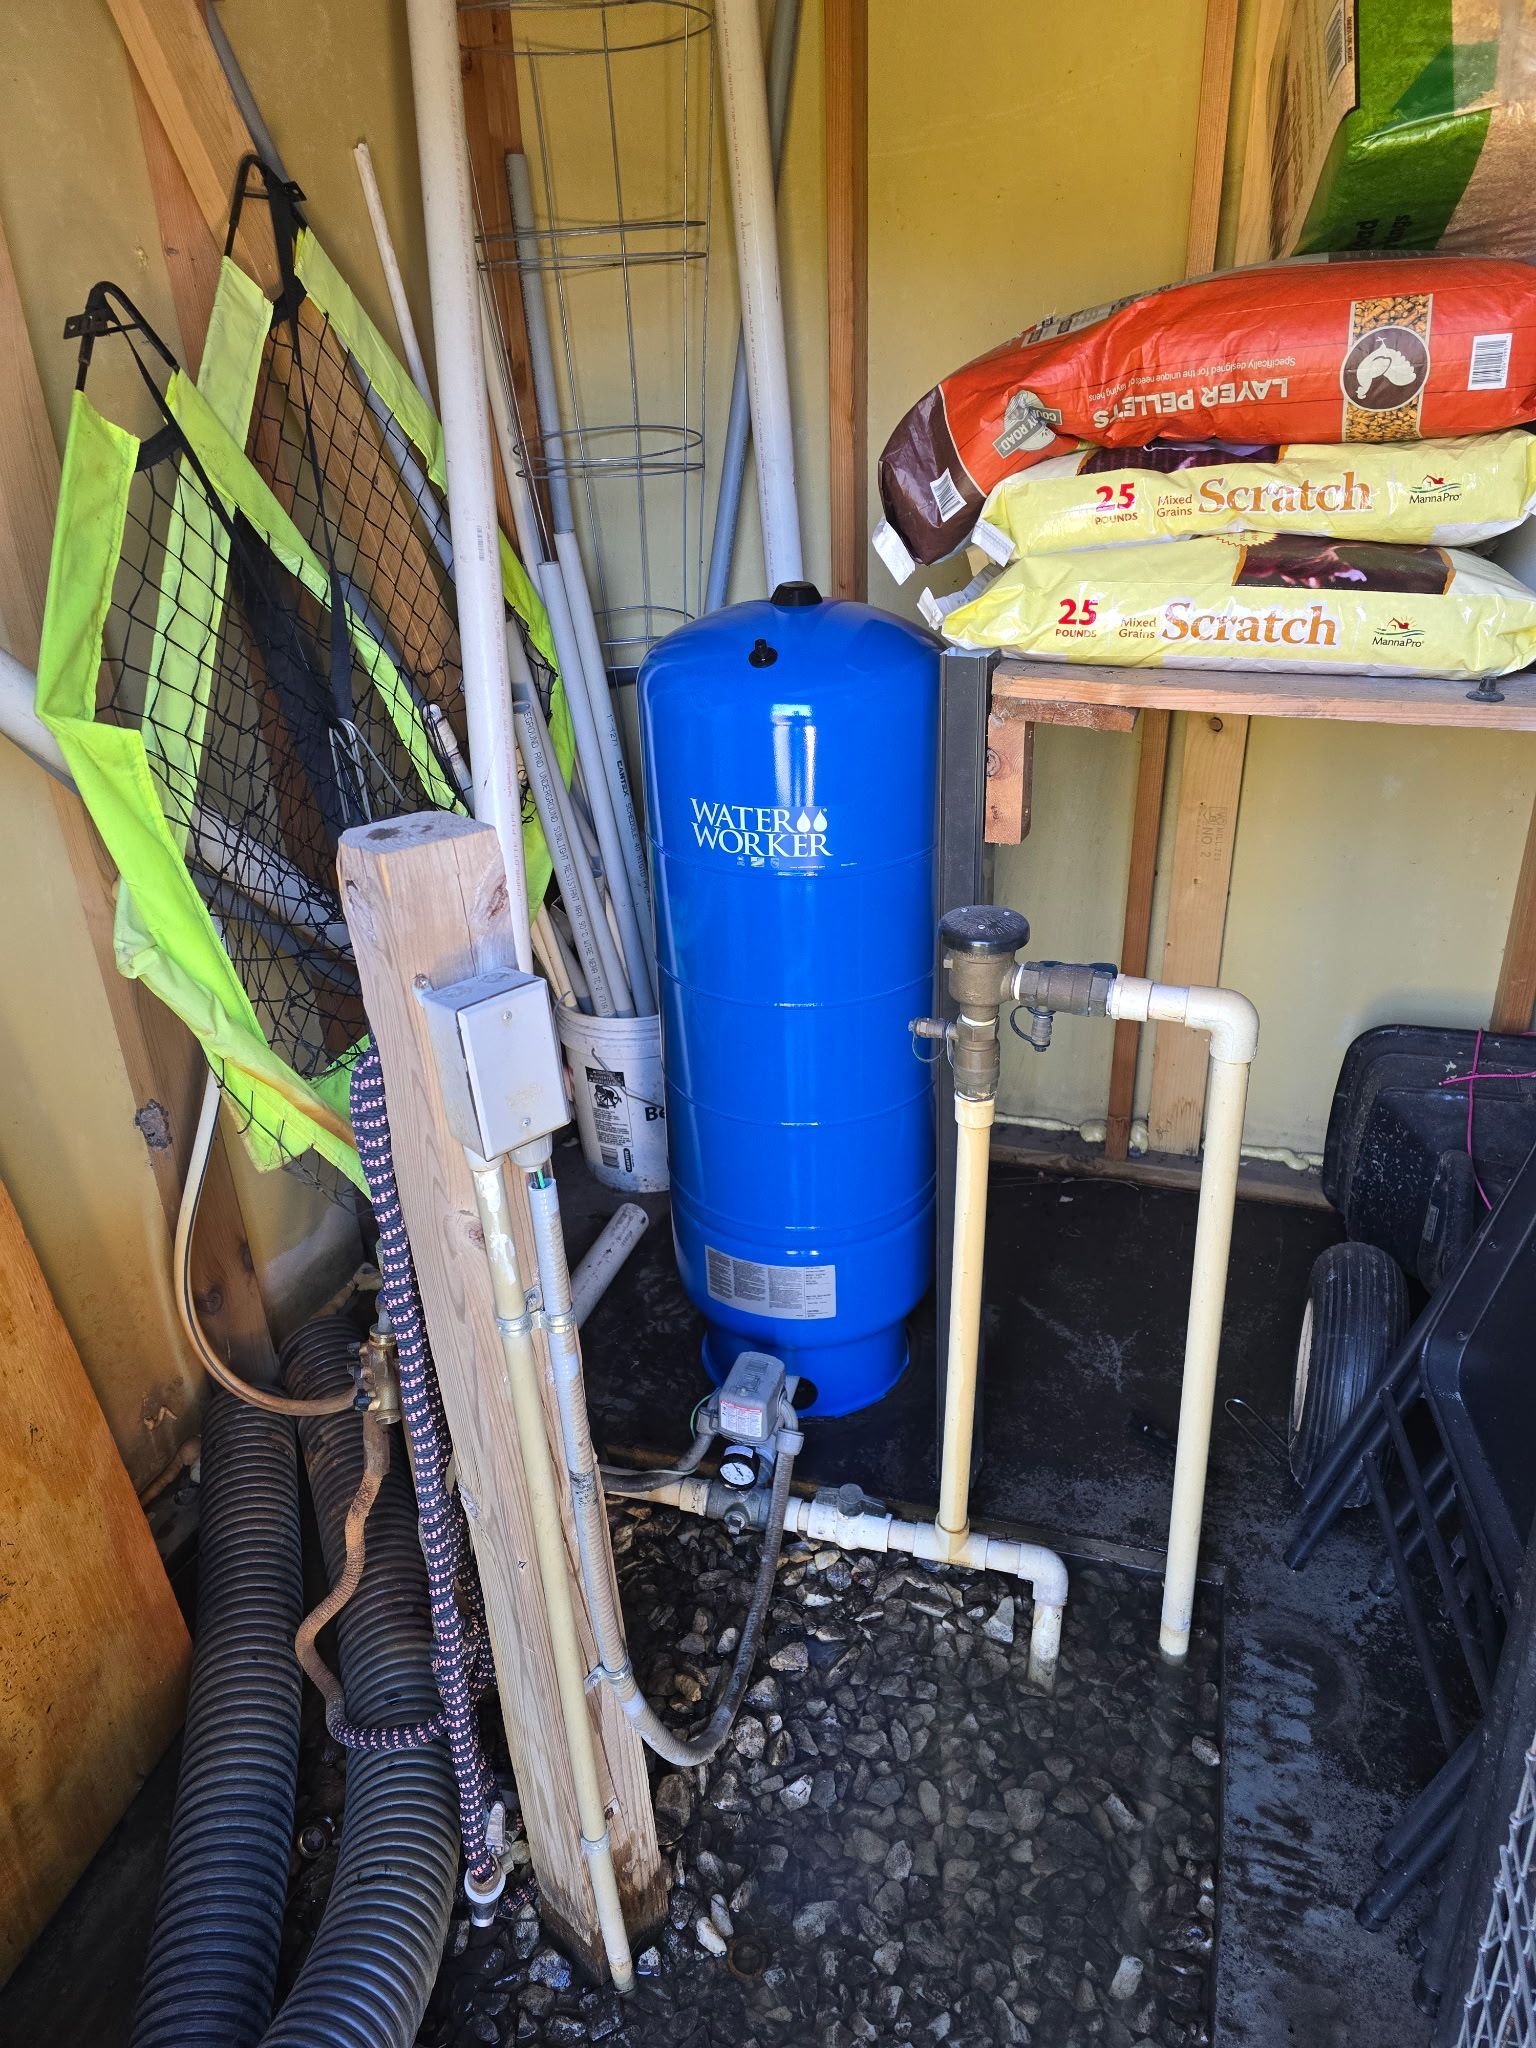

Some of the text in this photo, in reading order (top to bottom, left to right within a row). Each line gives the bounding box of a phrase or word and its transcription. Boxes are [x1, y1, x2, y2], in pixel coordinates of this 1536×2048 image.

[1210, 361, 1246, 376] designed
[1248, 357, 1296, 370] Specifically
[1156, 371, 1181, 382] unique
[1183, 370, 1195, 380] the
[1197, 368, 1210, 379] for
[1088, 389, 1105, 402] hens
[1106, 382, 1127, 398] laying
[1092, 378, 1288, 429] LAYER PELLETS
[1000, 423, 1029, 452] ROAD
[1095, 482, 1135, 512] 25
[1157, 493, 1193, 506] Mixed
[1198, 471, 1373, 513] Scratch
[1094, 512, 1138, 525] POUNDS
[1156, 506, 1193, 518] Grains
[1057, 598, 1099, 625] 25
[1120, 616, 1156, 628] Mixed
[1161, 602, 1337, 646] Scratch
[1055, 628, 1098, 638] POUNDS
[1118, 627, 1156, 640] Grains
[535, 751, 544, 768] AND
[538, 770, 560, 823] UNDERGROUND
[617, 760, 629, 797] CANTEX
[626, 802, 637, 838] SCHEDULE
[635, 842, 640, 851] 40
[689, 798, 794, 834] WATER
[553, 825, 568, 860] SUNLIGHT
[690, 822, 834, 858] WORKER
[564, 864, 579, 902] RESISTANT
[584, 939, 592, 955] WIRE
